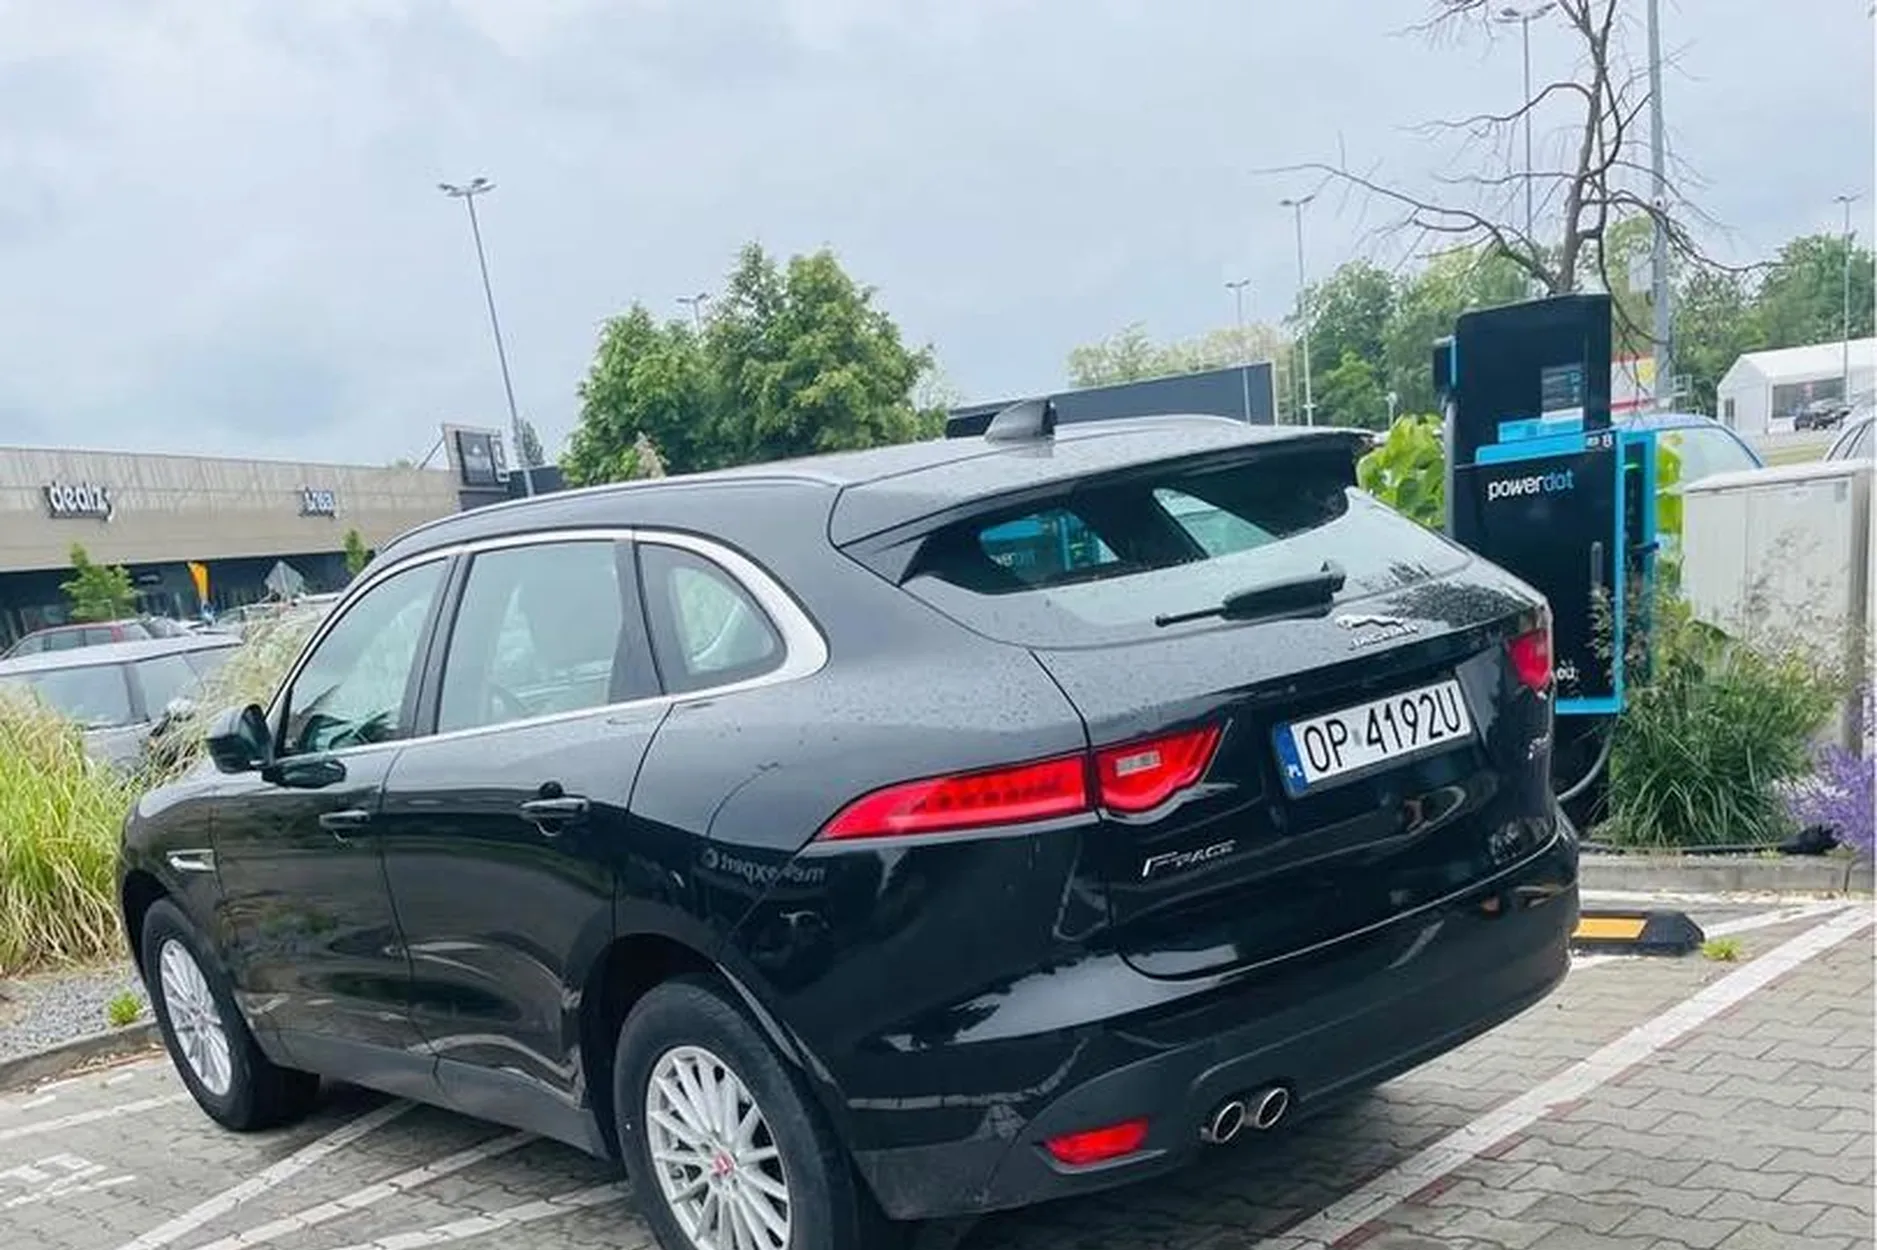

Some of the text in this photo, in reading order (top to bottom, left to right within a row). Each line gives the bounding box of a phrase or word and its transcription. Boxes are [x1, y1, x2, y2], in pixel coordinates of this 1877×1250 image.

[1487, 467, 1574, 501] powerdot
[1303, 718, 1348, 773] OP
[1365, 686, 1461, 754] 4192U
